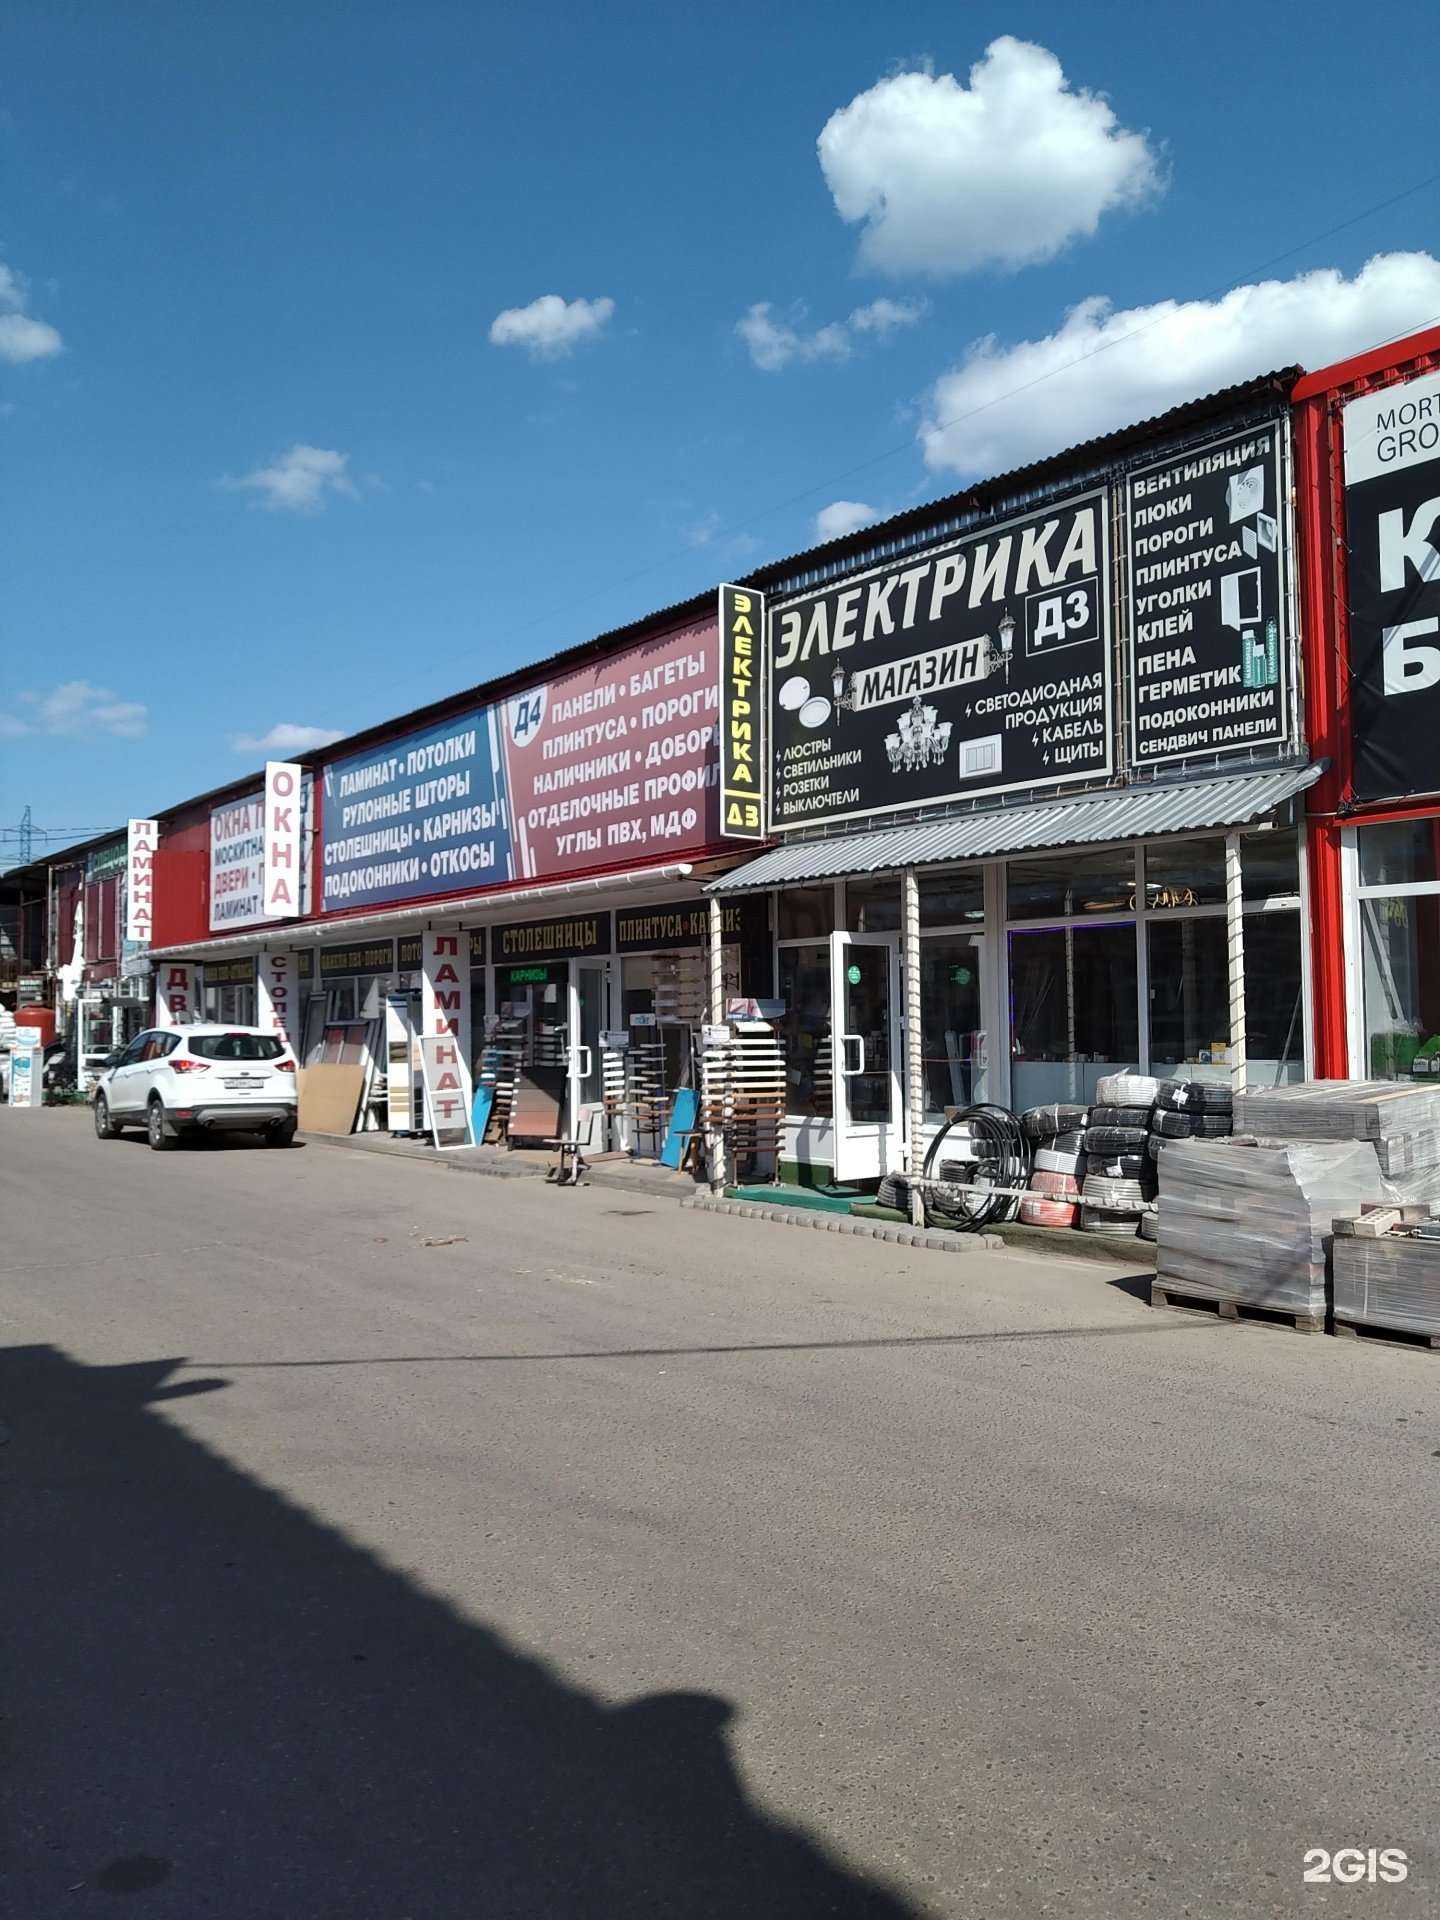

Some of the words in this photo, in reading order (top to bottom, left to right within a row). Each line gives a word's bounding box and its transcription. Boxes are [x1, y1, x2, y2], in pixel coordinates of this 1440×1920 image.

[1134, 435, 1270, 499] ВЕНТИЛЯЦИЯ
[1134, 494, 1192, 528] ЛЮКИ
[1135, 517, 1213, 557] ПОРОГИ
[1136, 540, 1242, 586] ПЛИНТУСА
[775, 508, 1098, 669] ЭЛЕКТРИКА
[1136, 579, 1212, 615] УГОЛКИ
[1137, 608, 1193, 643] КЛЕЙ
[861, 643, 979, 705] МАГАЗИН
[1138, 646, 1197, 676] ПЕНА
[552, 683, 616, 724] ПАНЕЛИ
[630, 651, 705, 696] БАГЕТЫ
[732, 593, 754, 782] ЭЛЕКТРИКА
[975, 672, 1103, 715] СВЕТОДИОДНАЯ
[1138, 665, 1242, 703] ГЕРМЕТИК
[514, 695, 541, 738] Д4
[542, 715, 628, 760] ПЛИНТУСА
[642, 685, 718, 729] ПОРОГИ
[1005, 695, 1103, 730] ПРОДУКЦИЯ
[1139, 689, 1274, 731] ПОДОКОННИКИ
[783, 737, 831, 761] ЛЮСТРЫ
[1043, 718, 1103, 744] КАБЕЛЬ
[1139, 730, 1208, 755] СЕНДВИЧ
[1212, 717, 1277, 742] ПАНЕЛИ
[340, 758, 397, 798] ЛАМИНАТ
[407, 730, 476, 776] ПОТОЛКИ
[533, 750, 630, 795] НАЛИЧНИКИ
[783, 749, 862, 779] СВЕТИЛЬНИКИ
[1054, 740, 1103, 764] ЩИТЫ
[342, 788, 411, 829] РУЛОННЫЕ
[415, 770, 470, 809] ШТОРЫ
[528, 784, 639, 829] ОТДЕЛОЧНЫЕ
[783, 775, 829, 797] РОЗЕТКИ
[783, 788, 860, 815] ВЫКЛЮЧТЕЛИ
[215, 804, 251, 842] ОКНА
[271, 771, 294, 904] ОКНА
[324, 824, 412, 866] СТОЛЕШНИЦЫ
[423, 800, 496, 843] КАРНИЗЫ
[556, 827, 601, 856] УГЛЫ
[607, 819, 646, 850] ПВХ,
[650, 807, 697, 837] МДФ
[215, 835, 265, 866] МОСКИТНА
[324, 856, 419, 898] ПОДОКОННИКИ
[430, 840, 495, 878] ОТКОСЫ
[132, 822, 152, 938] ЛАМИНАТ
[215, 866, 249, 897] ДВЕРИ
[215, 895, 258, 921] ЛАМИНАТ
[619, 914, 682, 942] ПЛИНТУСА
[502, 921, 597, 954] СТОЛЕШНИЦЫ
[433, 936, 461, 1118] ЛАМИНАТ
